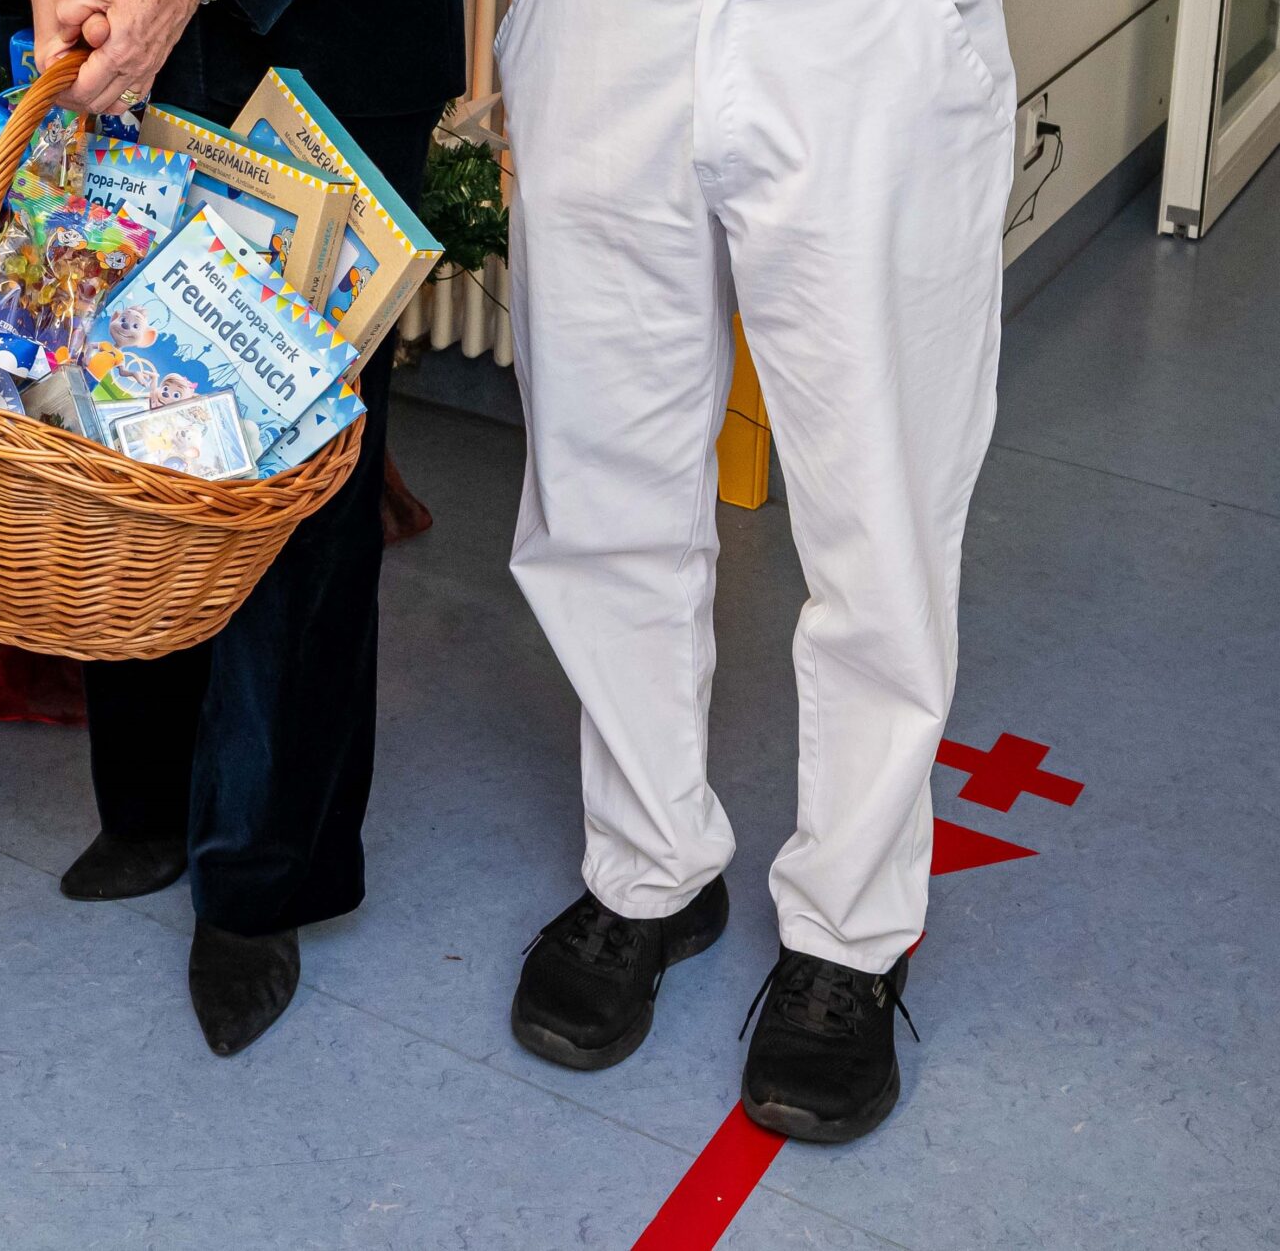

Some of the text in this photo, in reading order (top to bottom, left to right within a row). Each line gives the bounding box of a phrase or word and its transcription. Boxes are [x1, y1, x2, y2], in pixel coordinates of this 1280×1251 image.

[86, 172, 148, 196] ropa-Park
[186, 137, 270, 185] ZAUBERMALTAFEL
[198, 261, 228, 295] Mein
[162, 259, 297, 402] Freundebuch
[227, 288, 300, 364] Europa-Park
